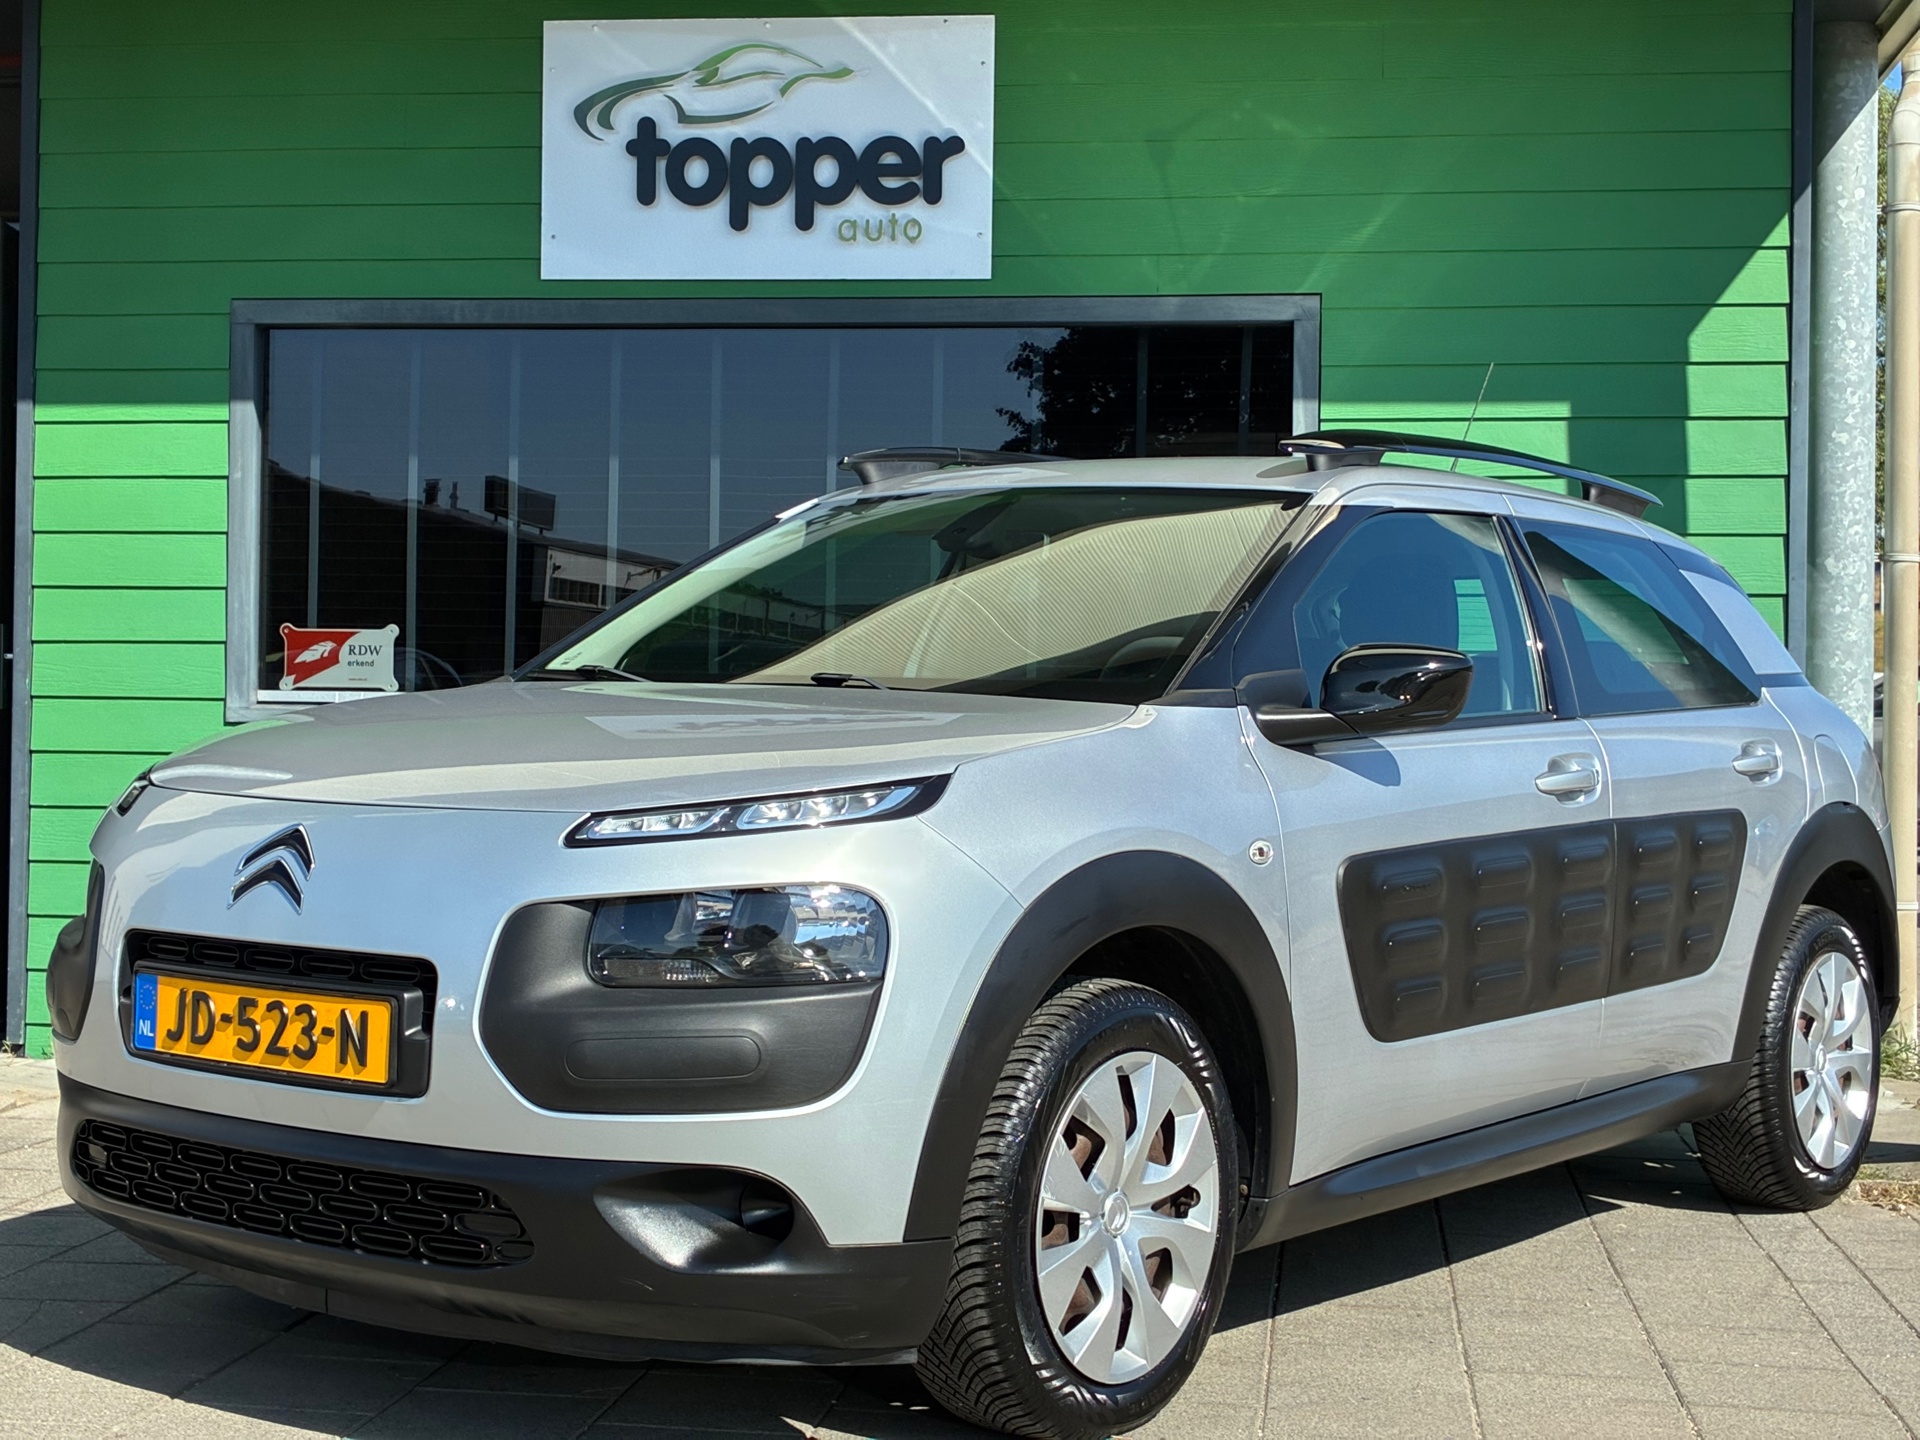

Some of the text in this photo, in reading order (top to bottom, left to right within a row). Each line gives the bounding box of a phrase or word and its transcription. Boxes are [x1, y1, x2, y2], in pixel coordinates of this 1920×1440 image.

[626, 116, 965, 231] topper
[837, 213, 922, 243] auto
[348, 645, 382, 656] RDW
[347, 659, 375, 667] erkend
[138, 1018, 154, 1037] NL
[166, 987, 368, 1067] JD-523-N
